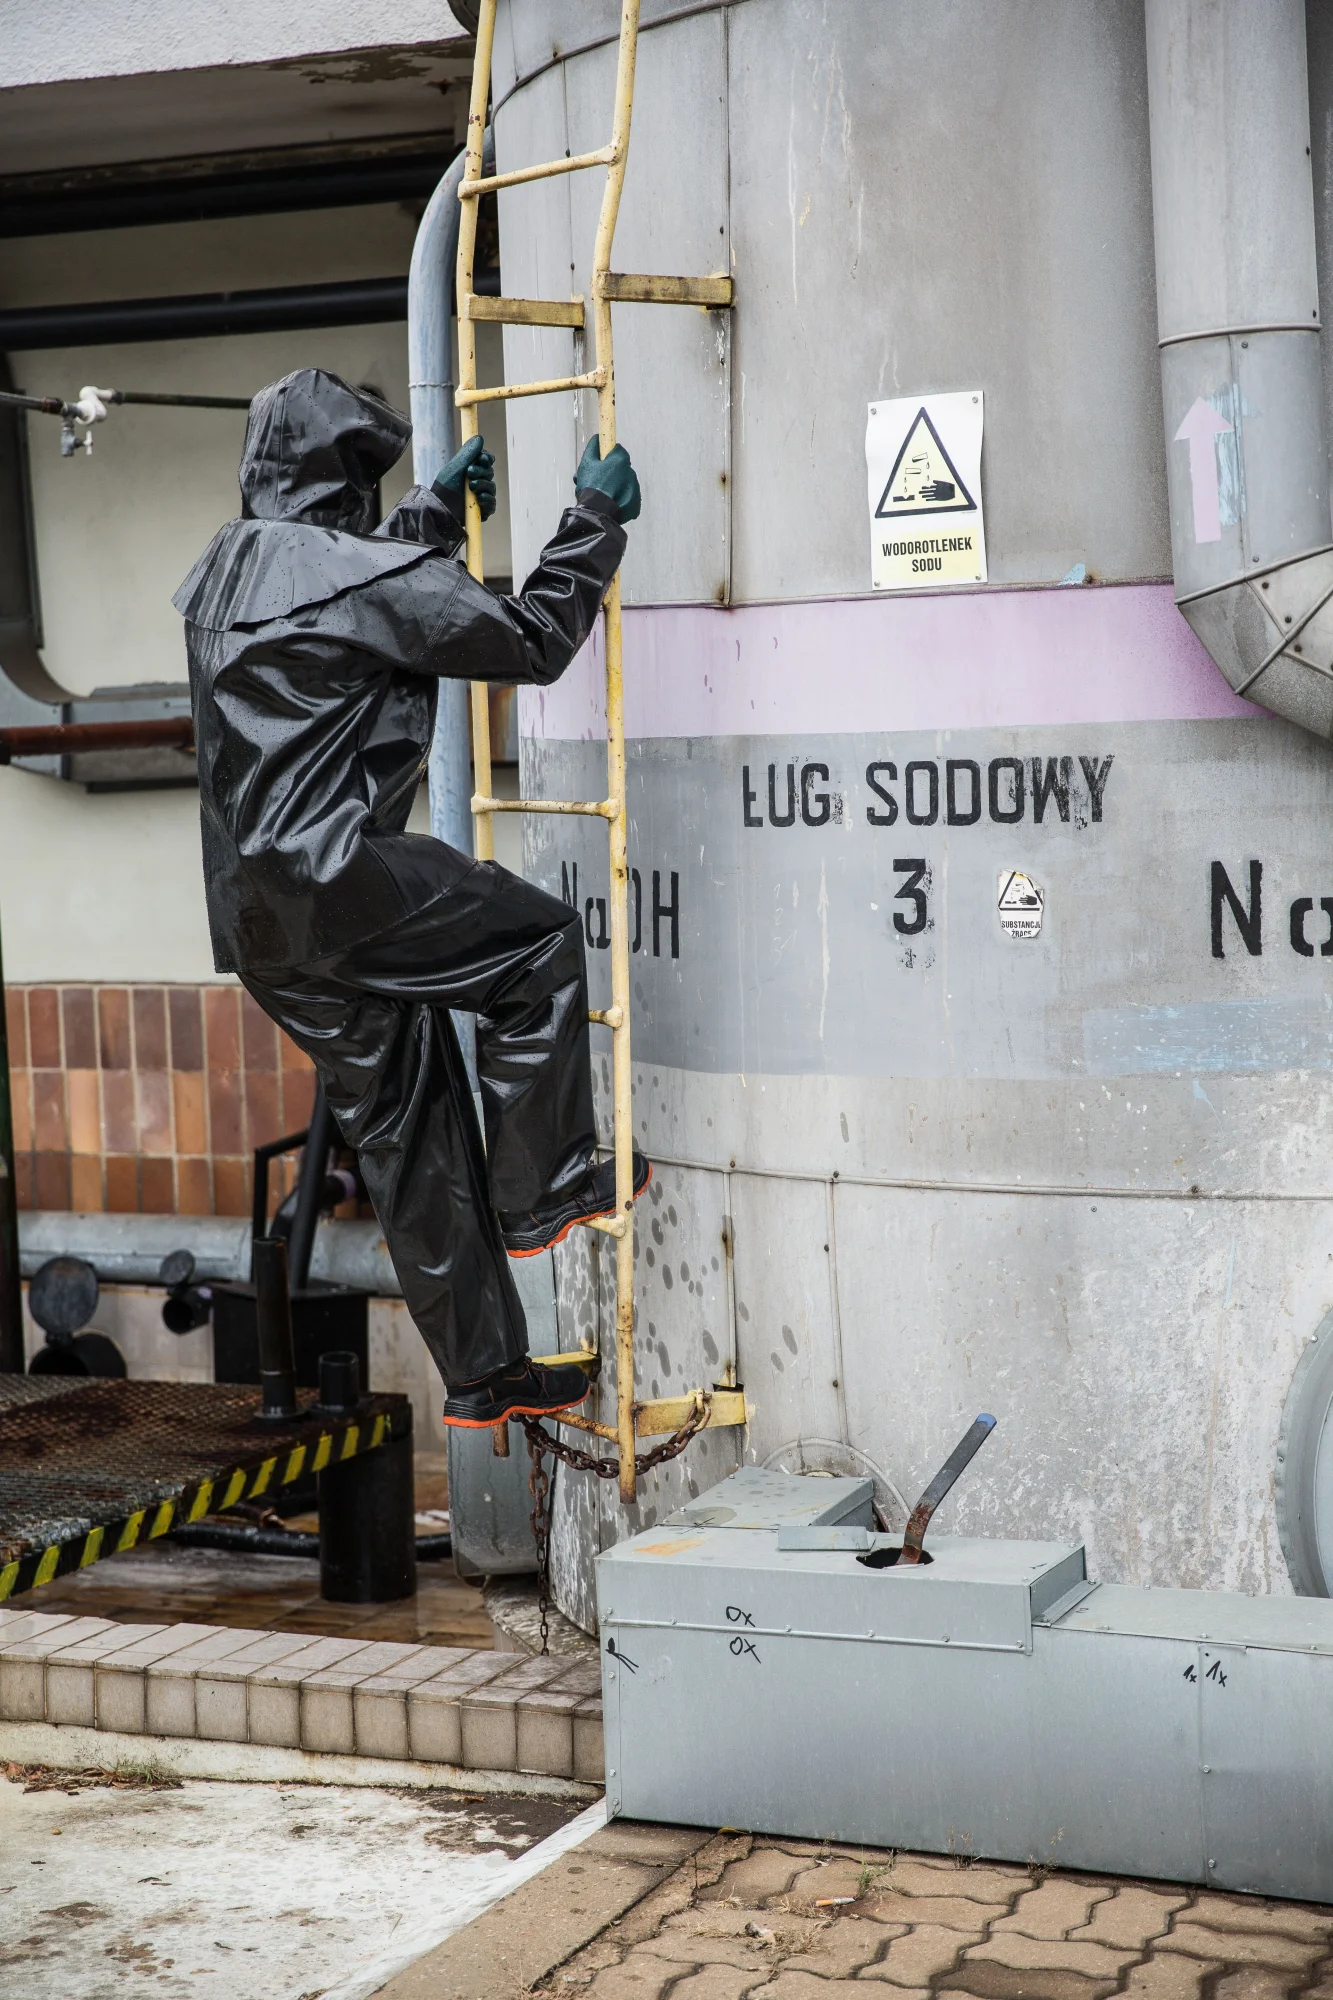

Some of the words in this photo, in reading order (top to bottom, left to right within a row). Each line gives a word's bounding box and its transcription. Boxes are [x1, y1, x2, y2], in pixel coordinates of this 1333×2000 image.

[882, 537, 972, 557] WODOROTLENEK
[911, 557, 942, 572] SODU
[742, 762, 831, 828] ŁUG
[865, 754, 1115, 826] SODOWY
[893, 858, 928, 936] 3
